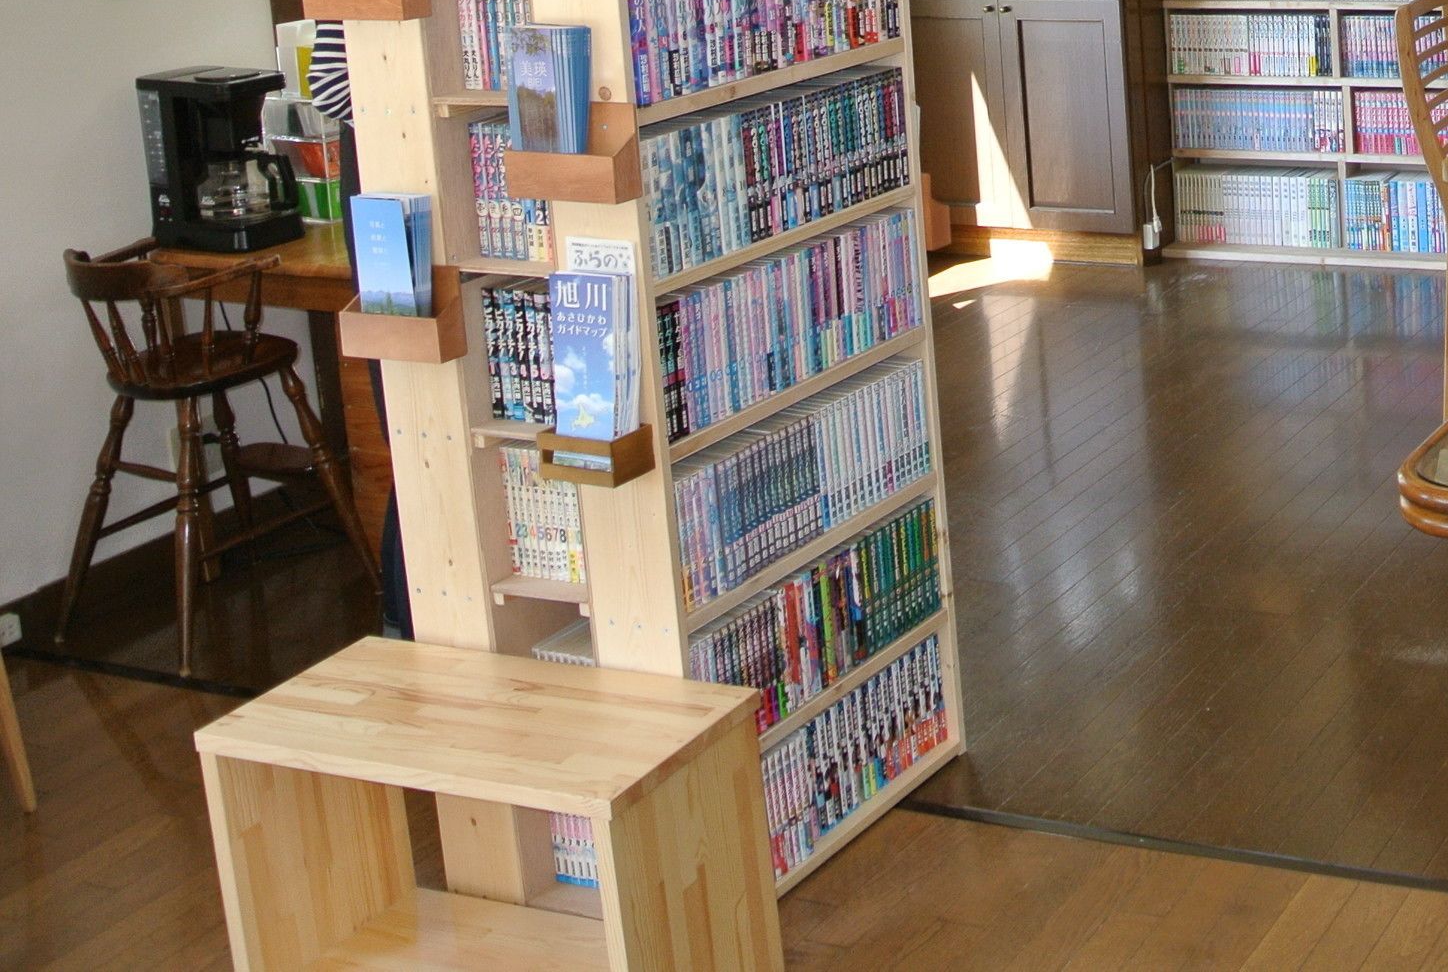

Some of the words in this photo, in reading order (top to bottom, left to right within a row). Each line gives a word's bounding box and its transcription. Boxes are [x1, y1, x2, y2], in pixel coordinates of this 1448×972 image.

[519, 60, 547, 77] 美瑛
[536, 210, 544, 224] 2
[574, 250, 618, 269] ふらの
[555, 281, 608, 311] 旭川
[557, 312, 607, 325] あさひかわ
[557, 324, 608, 338] ガイドマップ
[546, 526, 552, 541] 6
[560, 527, 567, 543] 8
